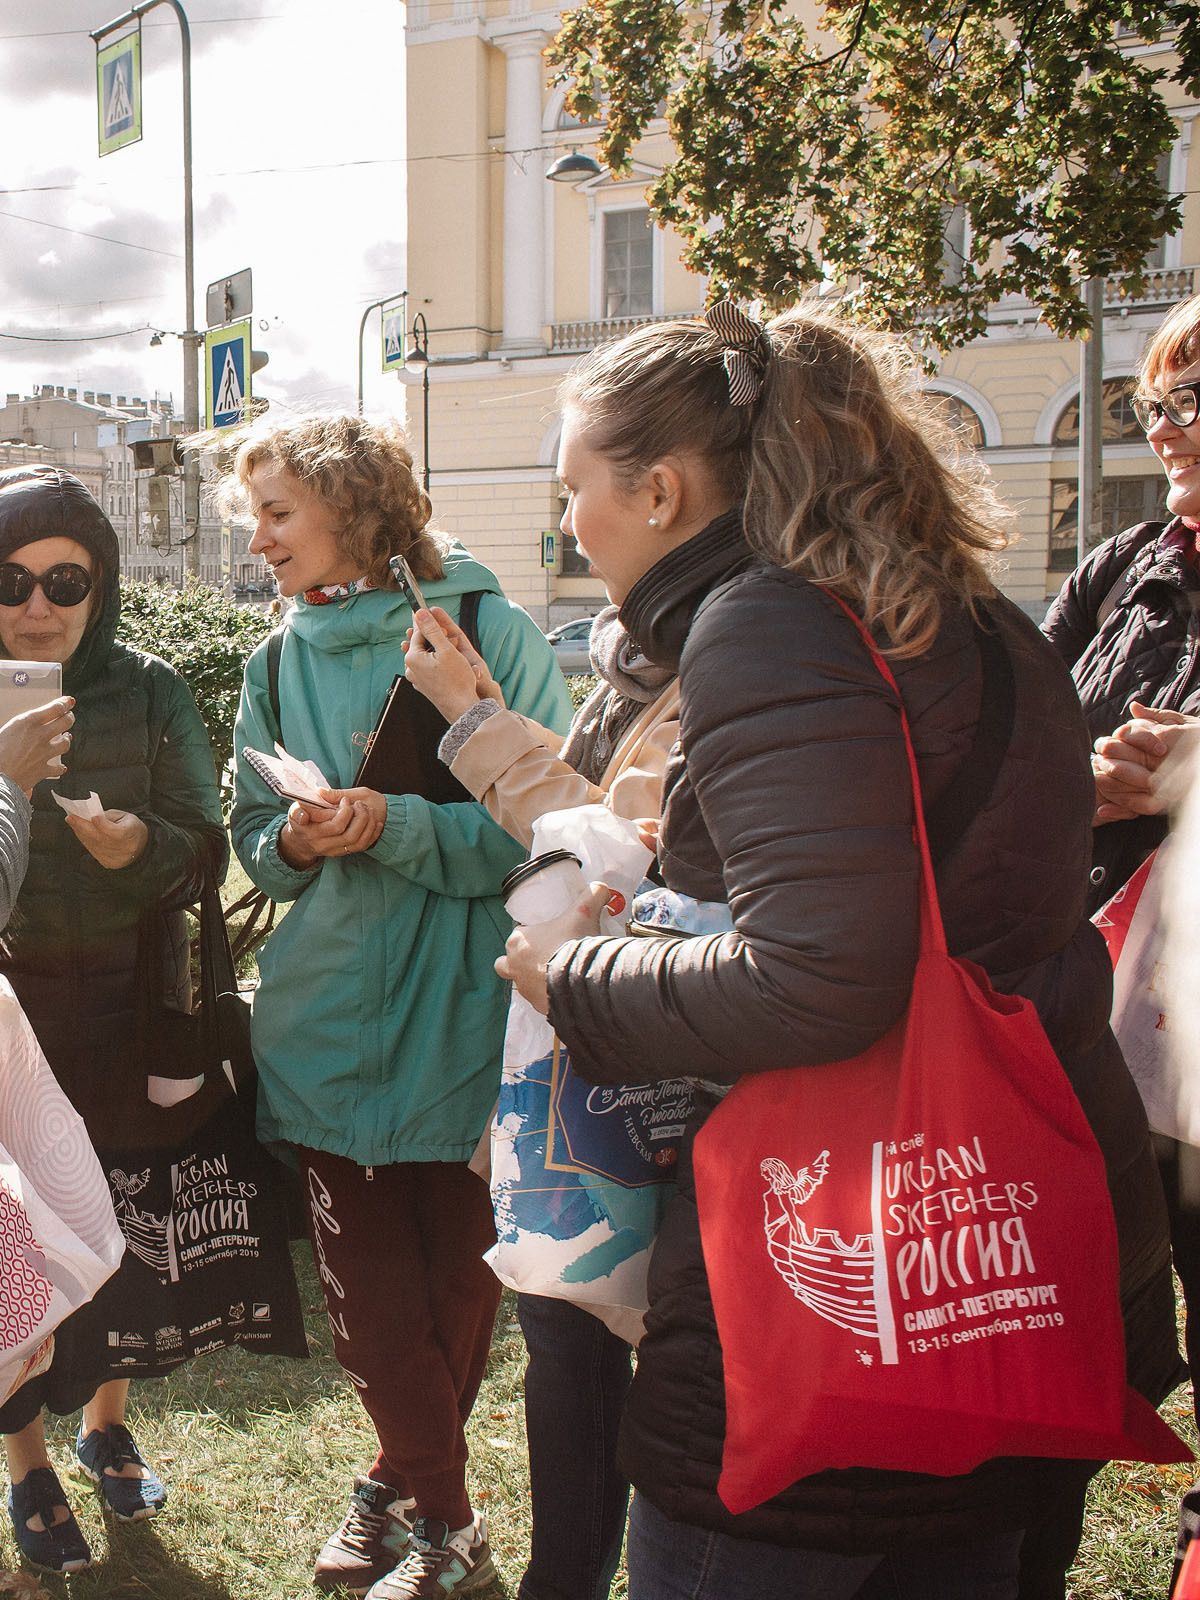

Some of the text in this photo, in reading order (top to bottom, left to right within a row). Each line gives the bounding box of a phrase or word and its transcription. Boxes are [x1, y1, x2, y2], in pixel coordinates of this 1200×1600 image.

[885, 1136, 987, 1199] URBAN
[174, 1179, 258, 1213] SKETCHERS
[885, 1182, 1038, 1236] SKETCHERS
[176, 1199, 249, 1245] РОССИЯ
[180, 1235, 260, 1262] САНКТ-ПЕТЕРБУРГ
[182, 1259, 205, 1273] 13-15
[239, 1248, 260, 1258] 2019
[896, 1216, 1036, 1300] РОССИЯ
[903, 1284, 1059, 1332] САНКТ-ПЕТЕРБУРГ
[907, 1312, 1065, 1354] 13-15 сентября 2019
